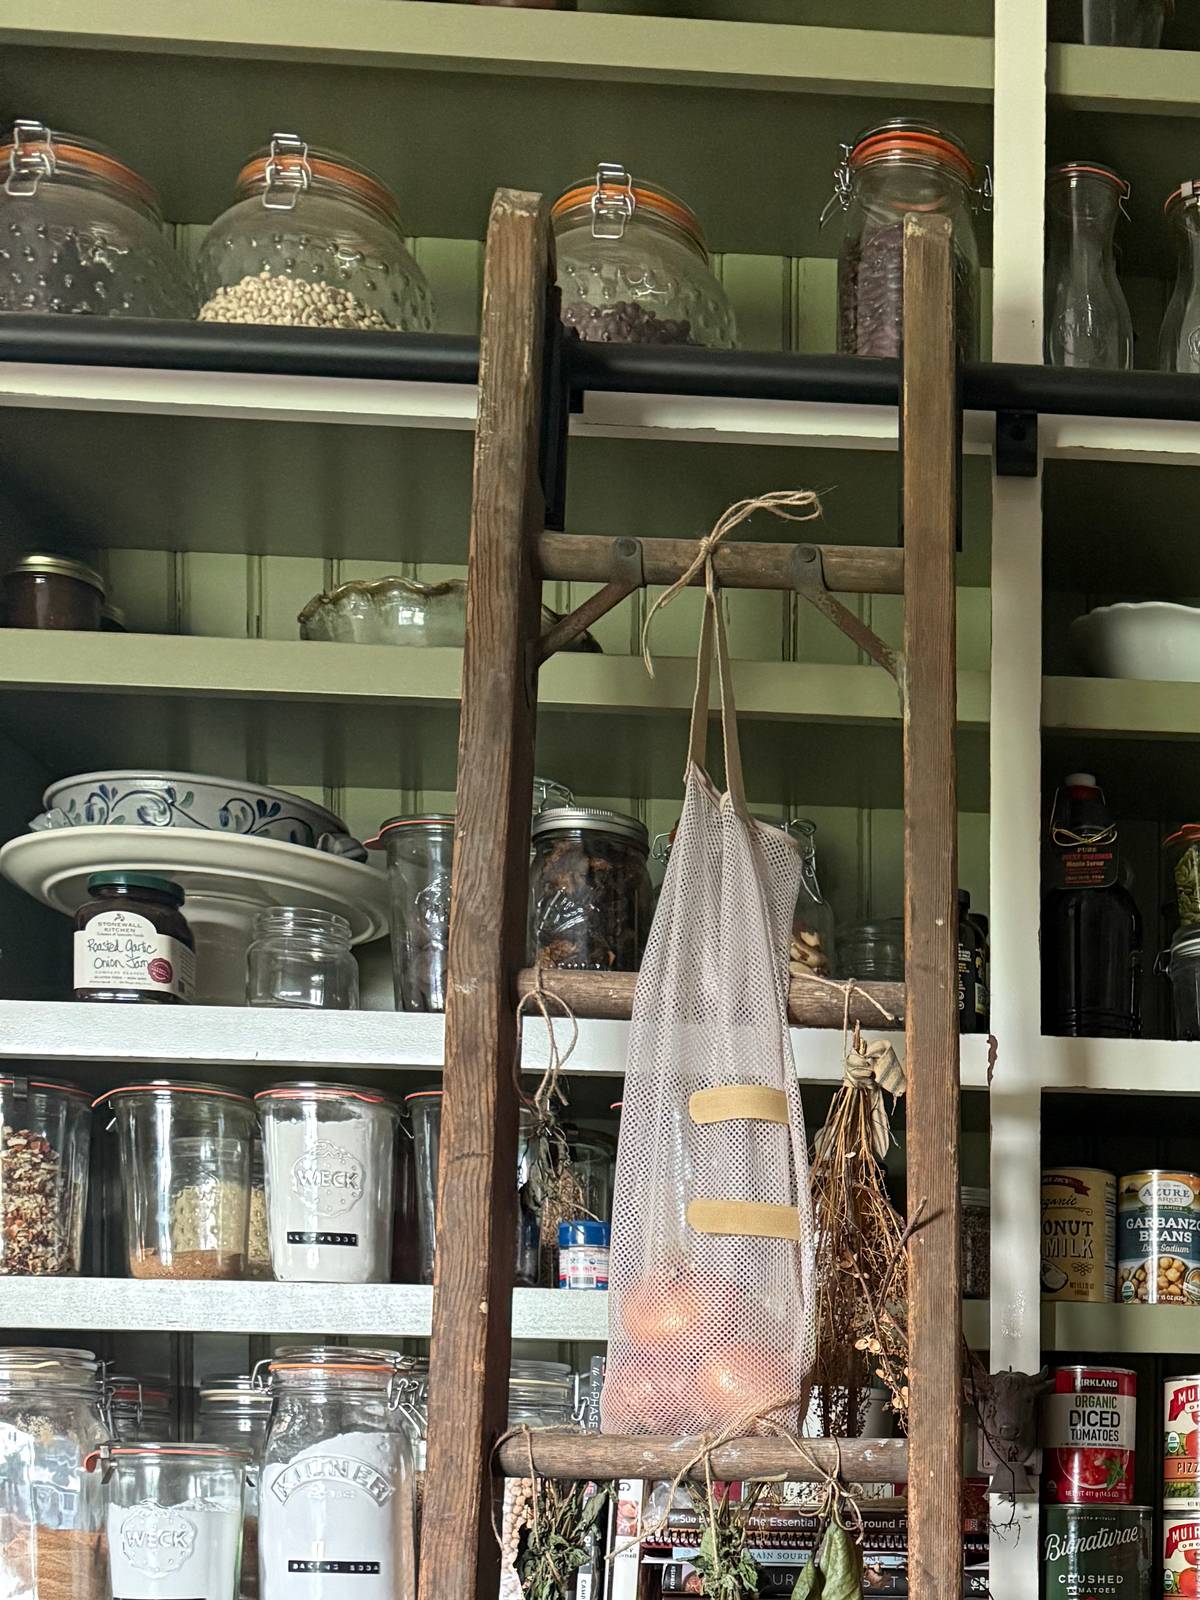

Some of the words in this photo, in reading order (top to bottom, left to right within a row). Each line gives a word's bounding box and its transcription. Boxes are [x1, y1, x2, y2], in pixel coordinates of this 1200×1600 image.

[88, 938, 123, 953] Roasted
[94, 956, 124, 969] Onion
[126, 956, 148, 968] Jam
[298, 1170, 359, 1189] WECK
[1143, 1188, 1190, 1198] AZURE
[1042, 1219, 1094, 1237] ONUT
[1045, 1238, 1094, 1259] MILK
[1160, 1243, 1190, 1254] Sodium
[1075, 1378, 1118, 1388] KIRKLAND
[588, 1381, 600, 1429] 4-PHASE
[1075, 1395, 1118, 1408] ORGANIC
[1069, 1410, 1121, 1428] DICED
[1070, 1428, 1119, 1442] TOMATOES
[276, 1460, 387, 1499] KILNER
[748, 1517, 768, 1527] The
[769, 1516, 817, 1528] Essential
[127, 1530, 189, 1548] WECK
[1044, 1526, 1139, 1562] Bionaturae
[1058, 1574, 1124, 1584] CRUSHED
